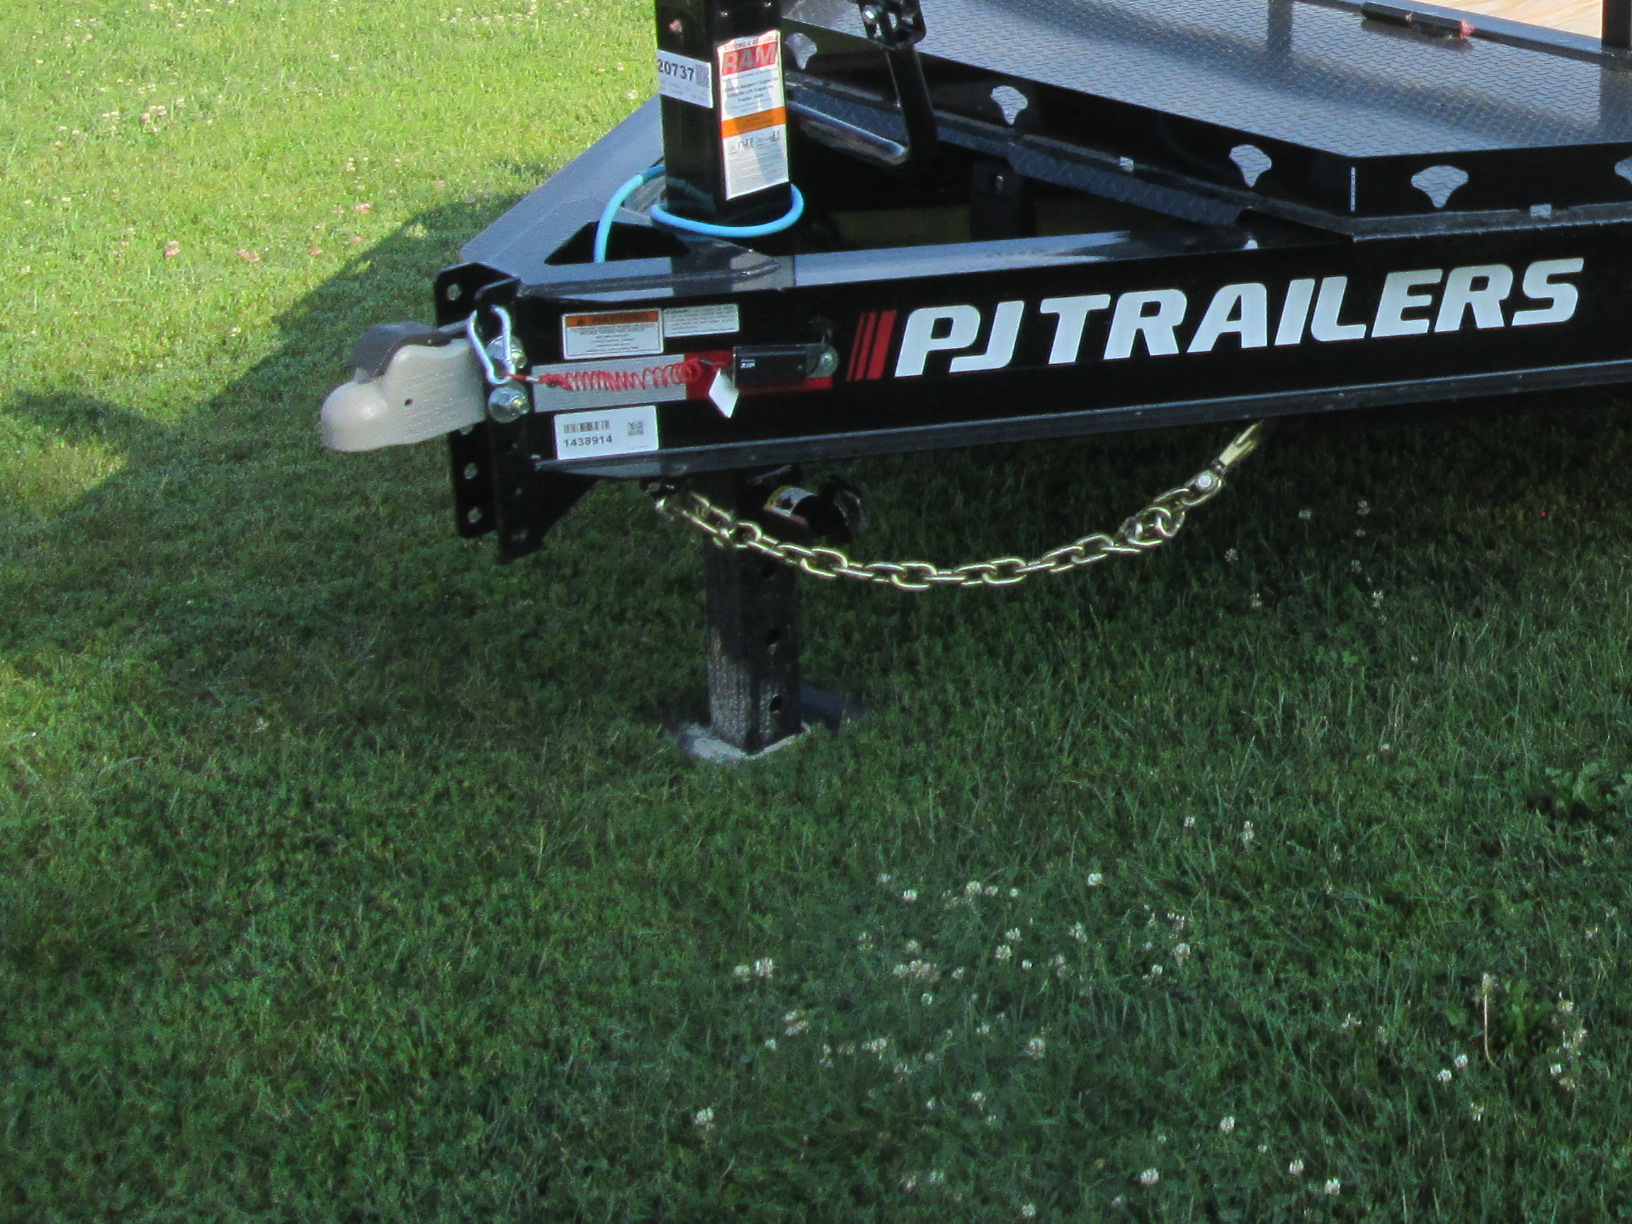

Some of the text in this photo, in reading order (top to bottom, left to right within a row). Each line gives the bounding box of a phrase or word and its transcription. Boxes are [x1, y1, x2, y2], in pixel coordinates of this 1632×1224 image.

[658, 58, 695, 81] 20737
[721, 42, 778, 75] RAM
[1039, 256, 1585, 366] TRAILERS
[563, 435, 613, 448] 1438914
